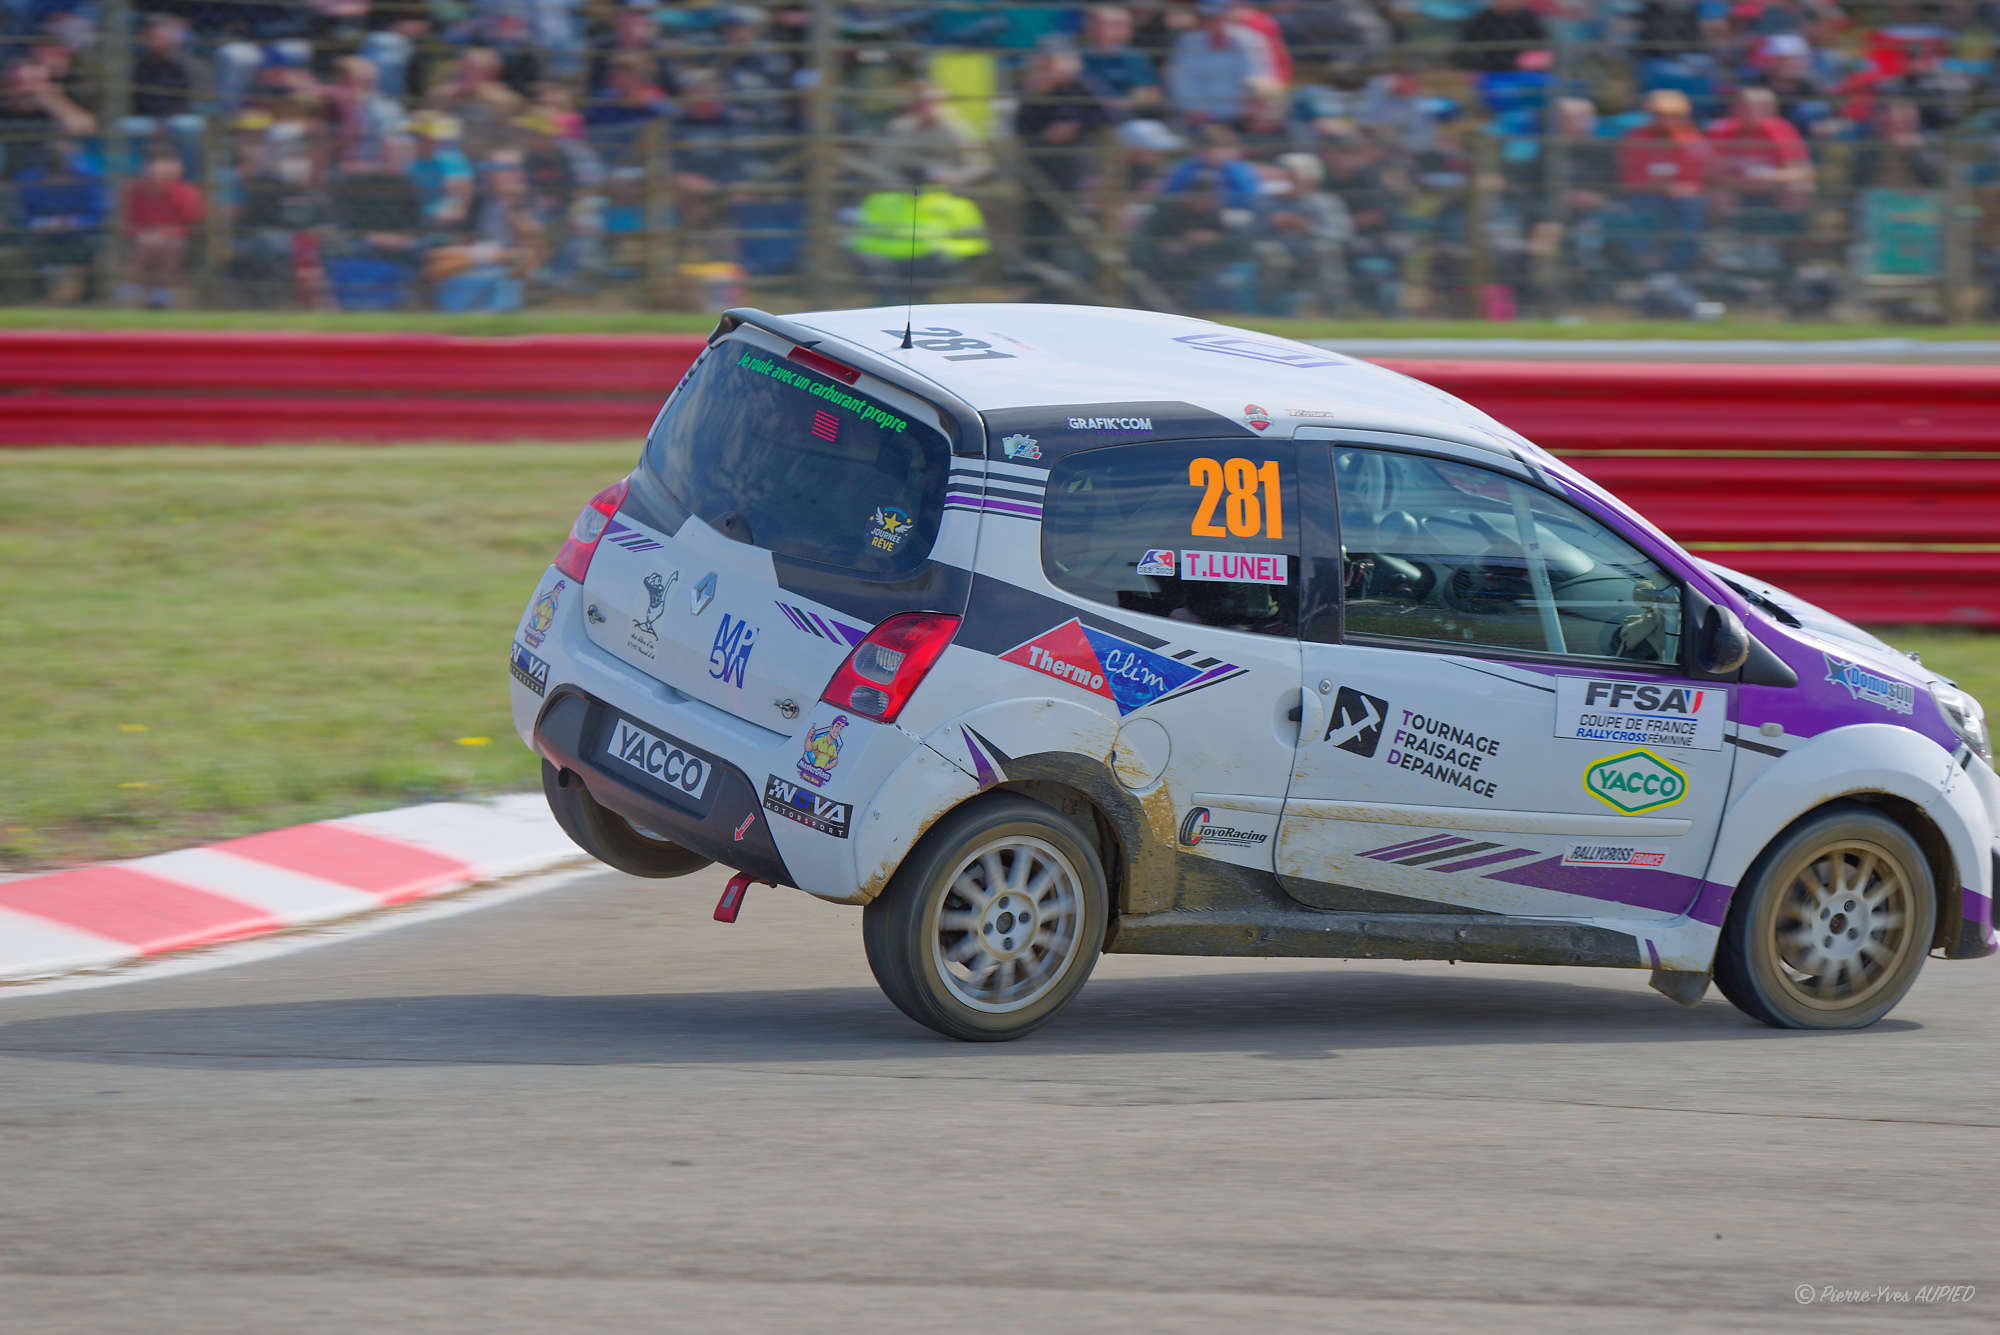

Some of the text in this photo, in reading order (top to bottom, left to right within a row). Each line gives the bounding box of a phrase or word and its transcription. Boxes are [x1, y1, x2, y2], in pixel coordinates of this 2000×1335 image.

[737, 352, 908, 433] Je roule avec un carburant propre
[1068, 417, 1153, 430] GRAFIK'COM
[1189, 457, 1283, 539] 281
[1185, 553, 1285, 581] T.LUNEL
[1028, 646, 1104, 690] Thermo
[1105, 649, 1165, 691] Clim
[1584, 681, 1688, 714] FFSA
[1402, 709, 1500, 757] TOURNAGE
[1576, 727, 1648, 743] RALLYCROSS
[1580, 714, 1697, 735] COUPE DE FRANCE
[619, 724, 703, 792] YACCO
[1393, 729, 1482, 772] FRAISAGE
[1386, 748, 1498, 799] DEPANNAGE
[1599, 768, 1677, 797] YACCO
[765, 801, 844, 837] MOTORSPORT
[1571, 845, 1635, 861] RALLYCROSS
